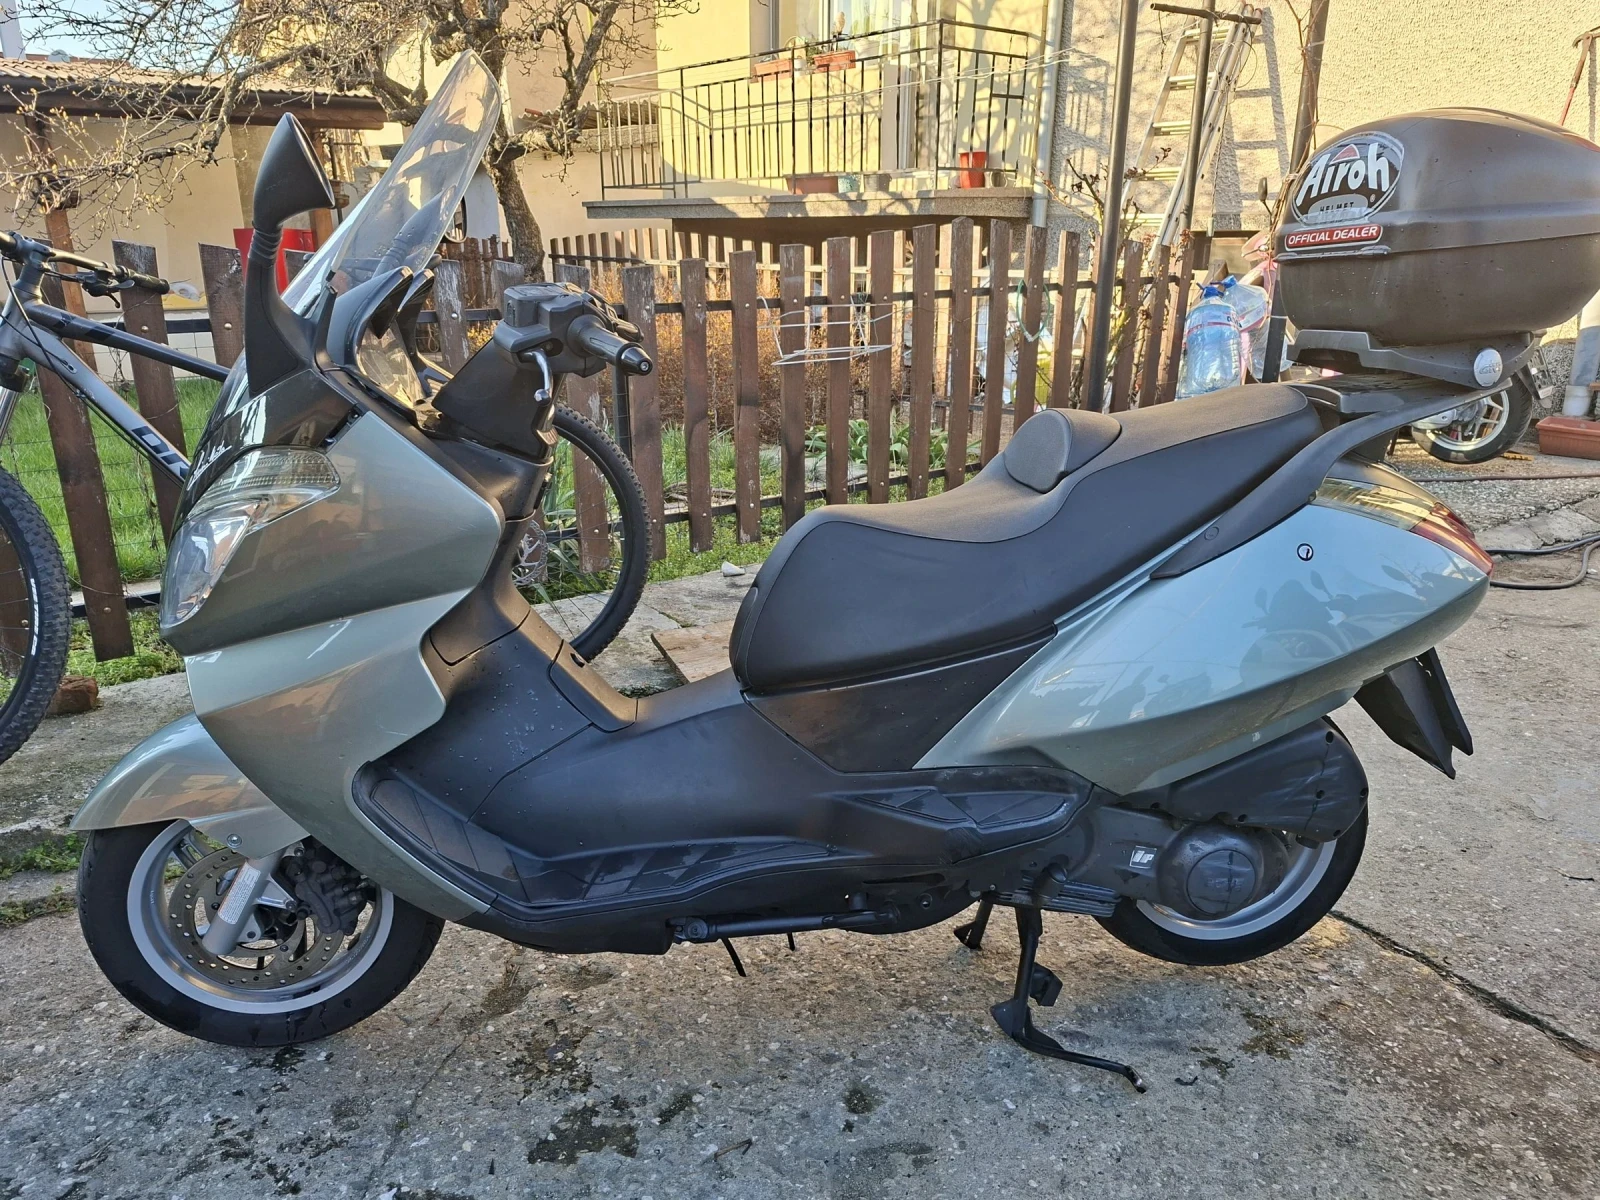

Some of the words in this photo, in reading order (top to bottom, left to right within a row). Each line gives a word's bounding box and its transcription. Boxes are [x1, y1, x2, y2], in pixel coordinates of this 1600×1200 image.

[1295, 142, 1390, 207] Airoh
[1319, 201, 1355, 213] HELMET
[1288, 232, 1331, 245] OFFICIAL
[1332, 226, 1378, 240] DEALER
